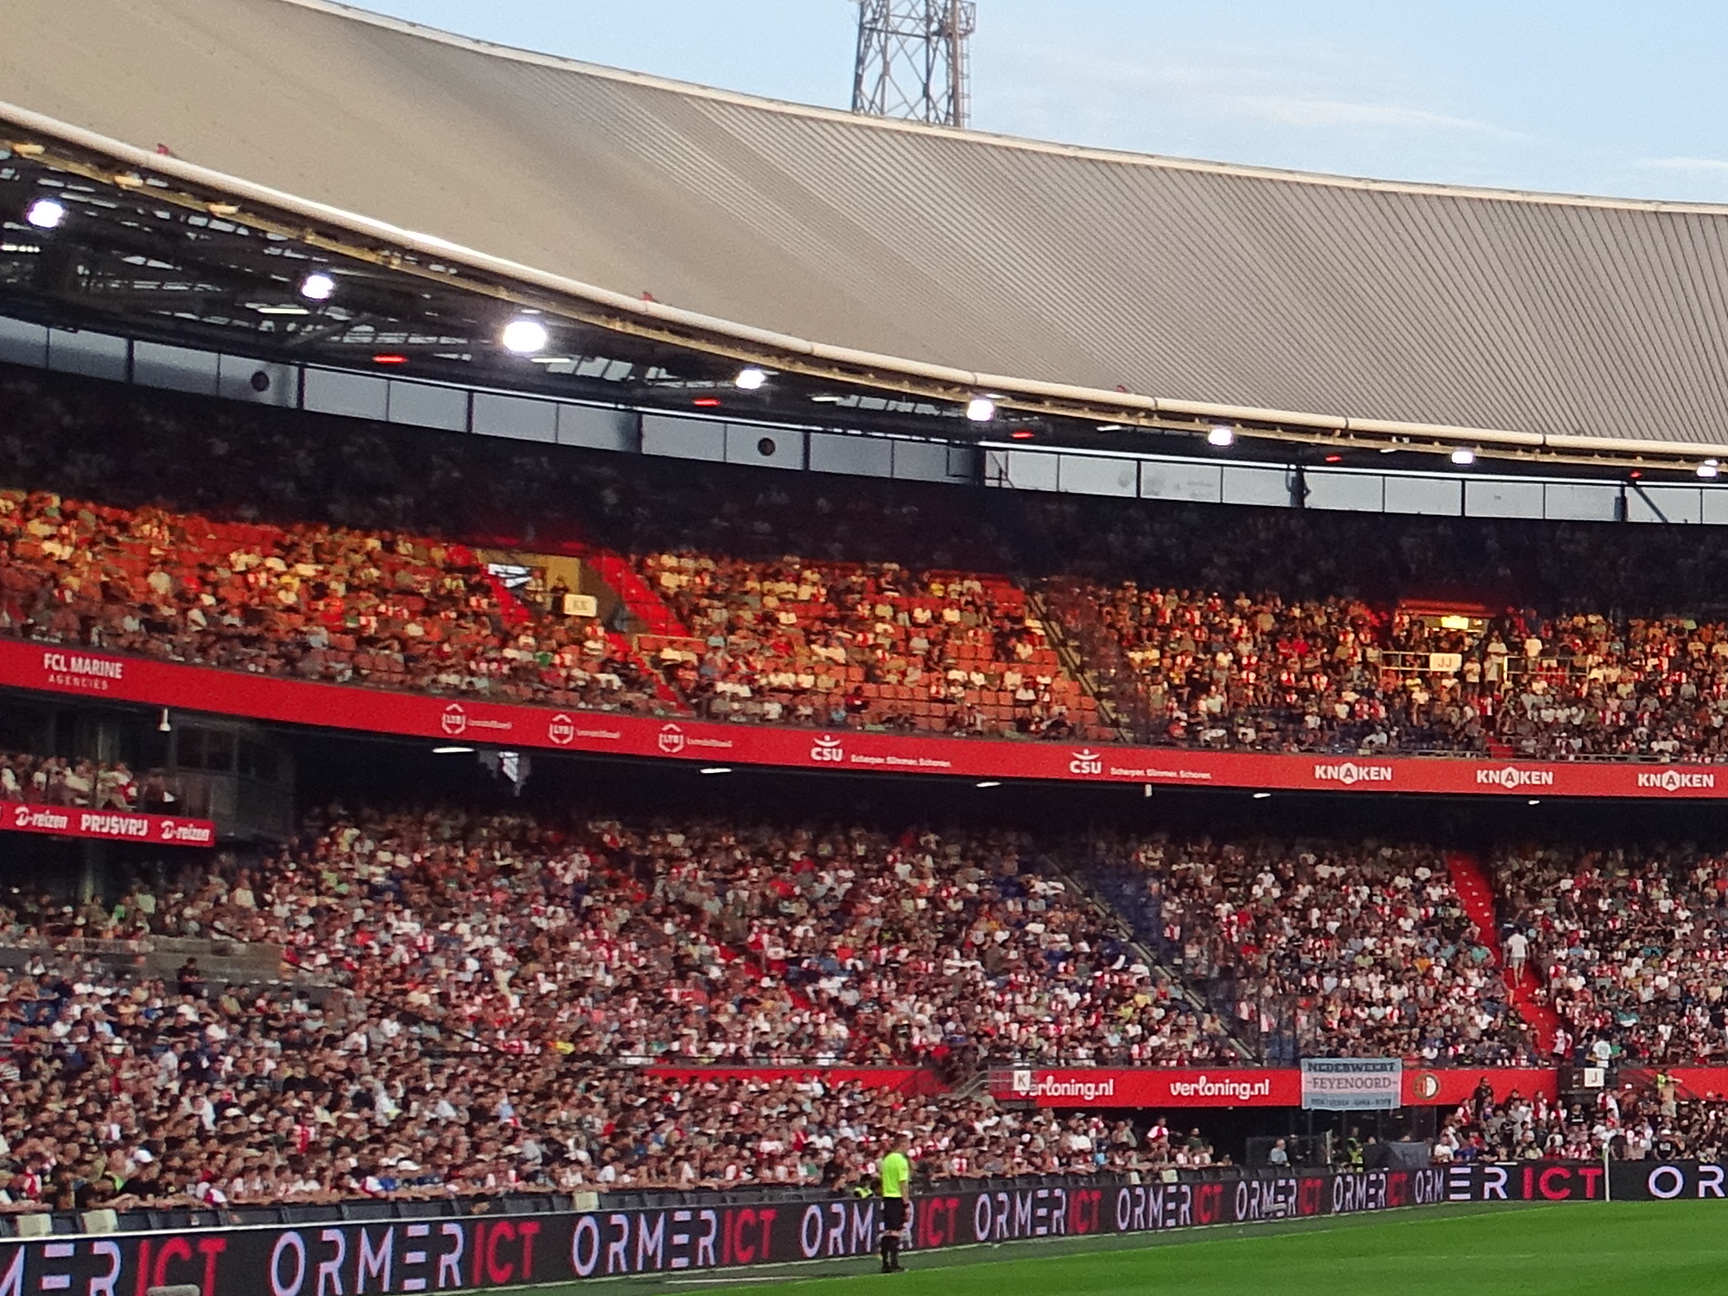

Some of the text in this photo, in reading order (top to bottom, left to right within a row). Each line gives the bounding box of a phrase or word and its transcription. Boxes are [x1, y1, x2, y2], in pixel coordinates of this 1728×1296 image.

[44, 653, 123, 679] FCL MARINE
[811, 747, 843, 762] CSU
[1070, 760, 1102, 774] CSU
[1314, 763, 1392, 784] KNAKEN
[1476, 767, 1553, 788] KNAKEN
[1638, 770, 1714, 791] KNAKEN
[1020, 1076, 1269, 1100] erloning.nl verloning.nl
